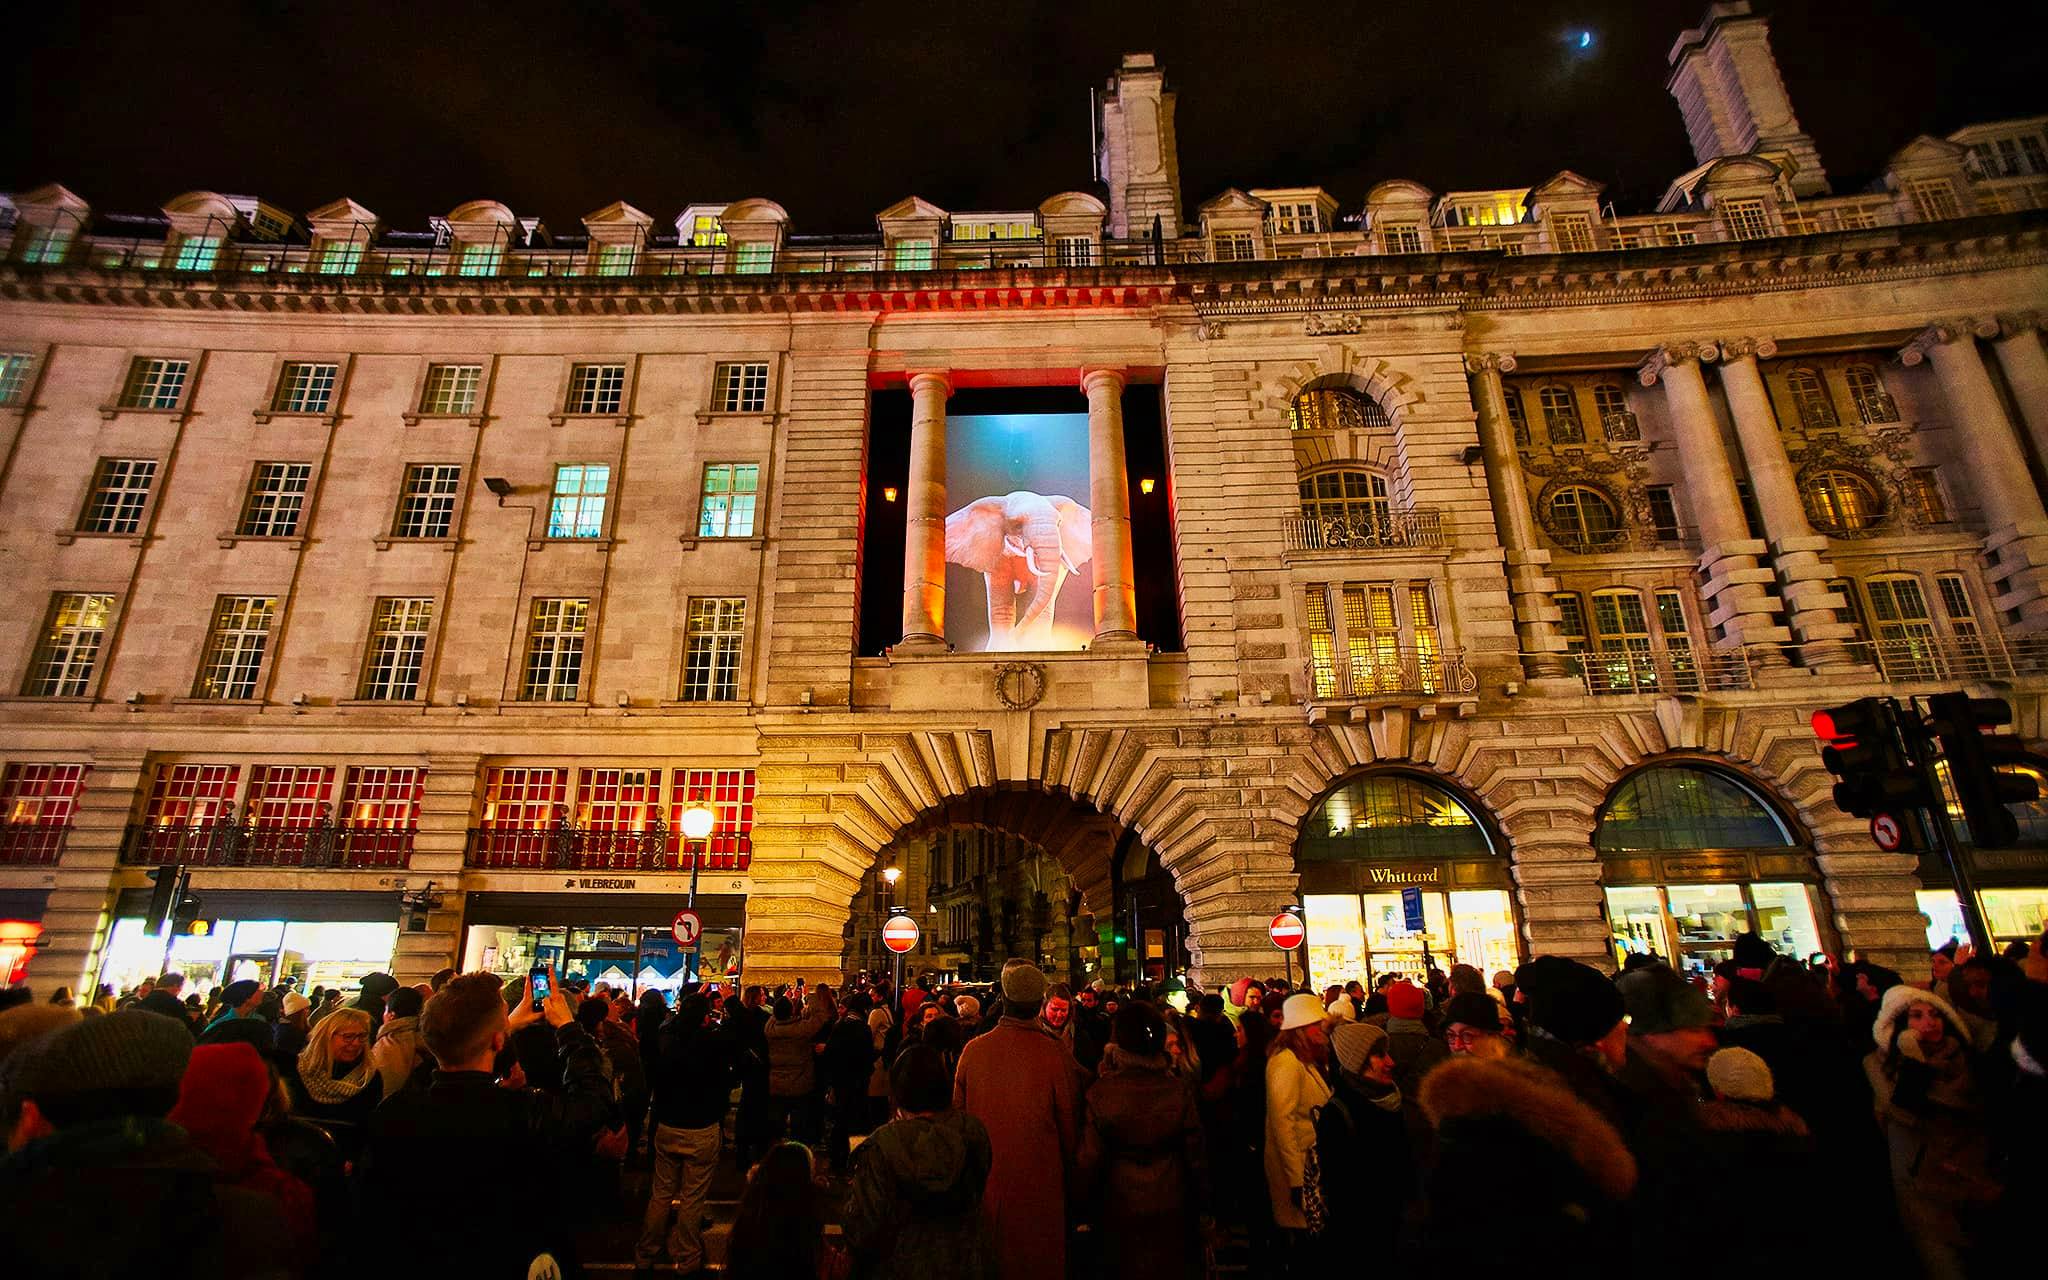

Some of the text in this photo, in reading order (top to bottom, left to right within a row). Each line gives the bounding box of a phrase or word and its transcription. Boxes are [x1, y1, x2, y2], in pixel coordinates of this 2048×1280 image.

[1370, 868, 1438, 883] Whittard
[579, 878, 636, 890] VILEBREQUIN
[732, 881, 742, 890] 63
